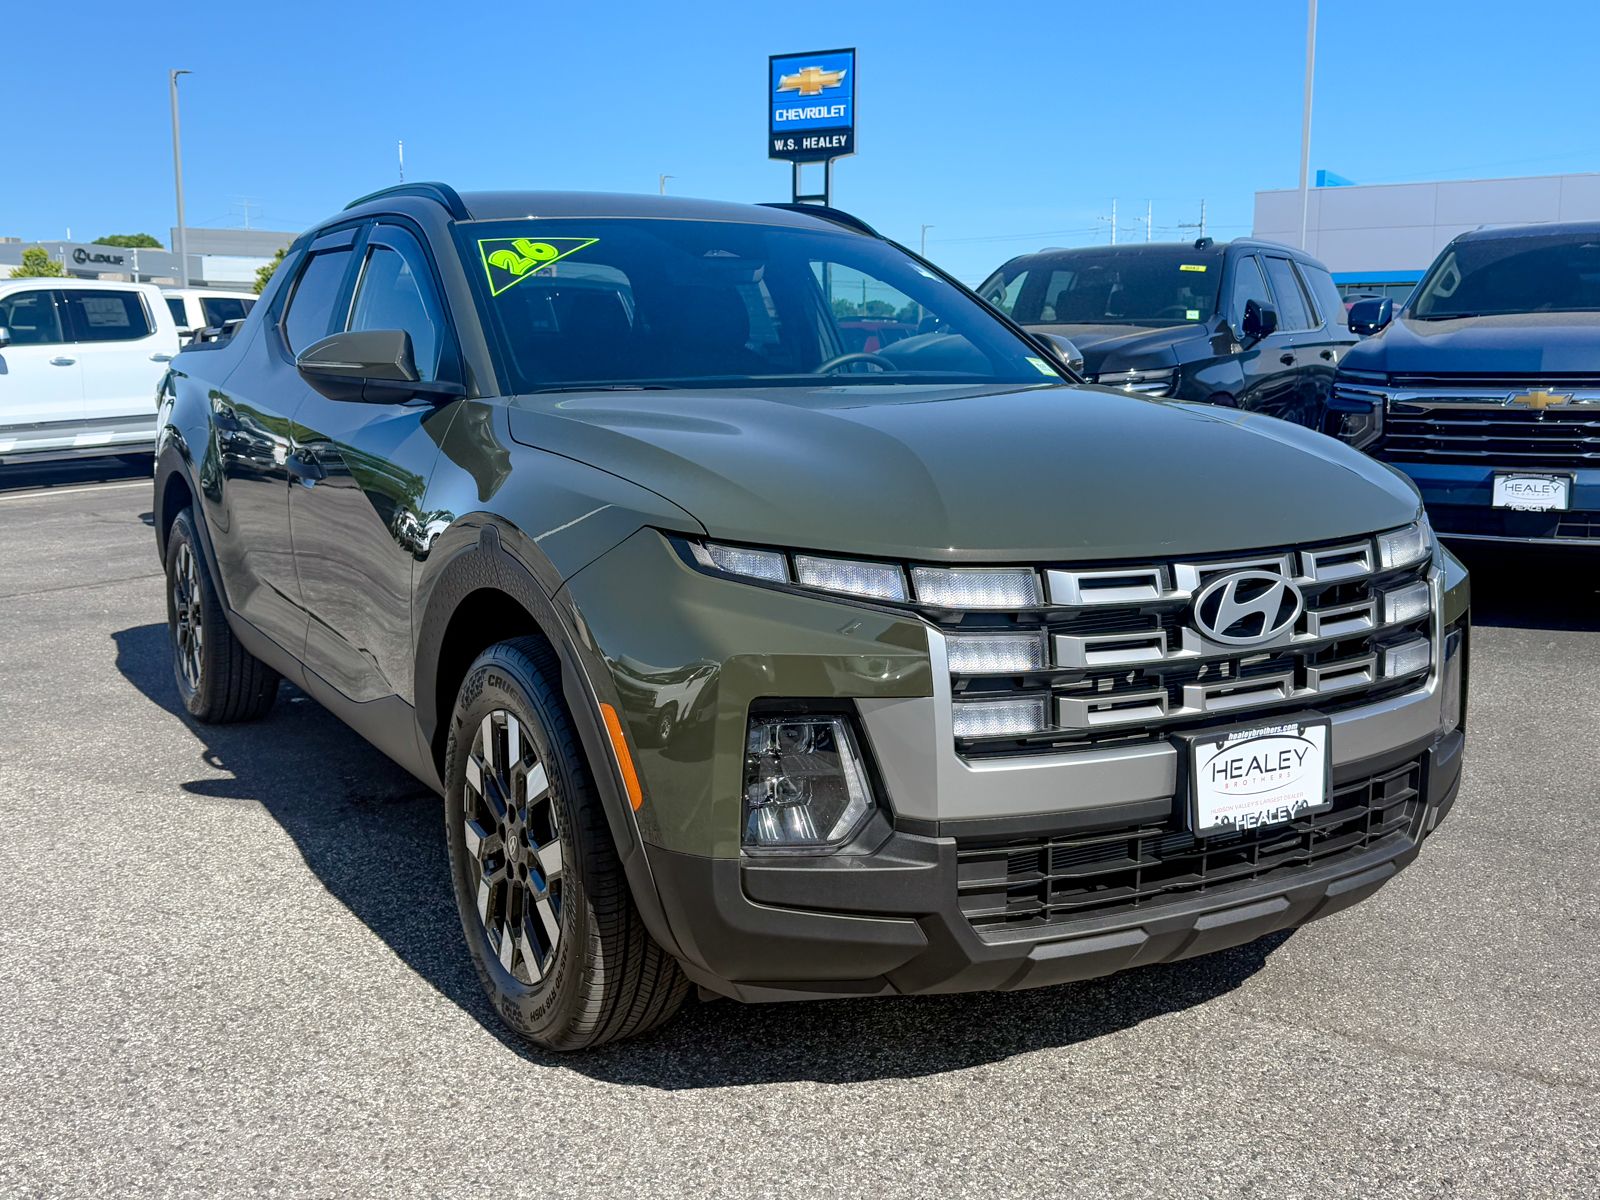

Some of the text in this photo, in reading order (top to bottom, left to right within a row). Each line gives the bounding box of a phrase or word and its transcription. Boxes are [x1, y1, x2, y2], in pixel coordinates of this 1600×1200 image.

[775, 104, 847, 121] CHEVROLET
[774, 135, 847, 151] W.S. HEALEY
[488, 238, 559, 276] 26
[1504, 483, 1560, 493] HEALEY
[1228, 723, 1299, 740] healeybrothers.com
[1212, 746, 1309, 782] HEALEY
[1225, 771, 1291, 789] BROTHERS
[1235, 802, 1298, 831] HEALEY
